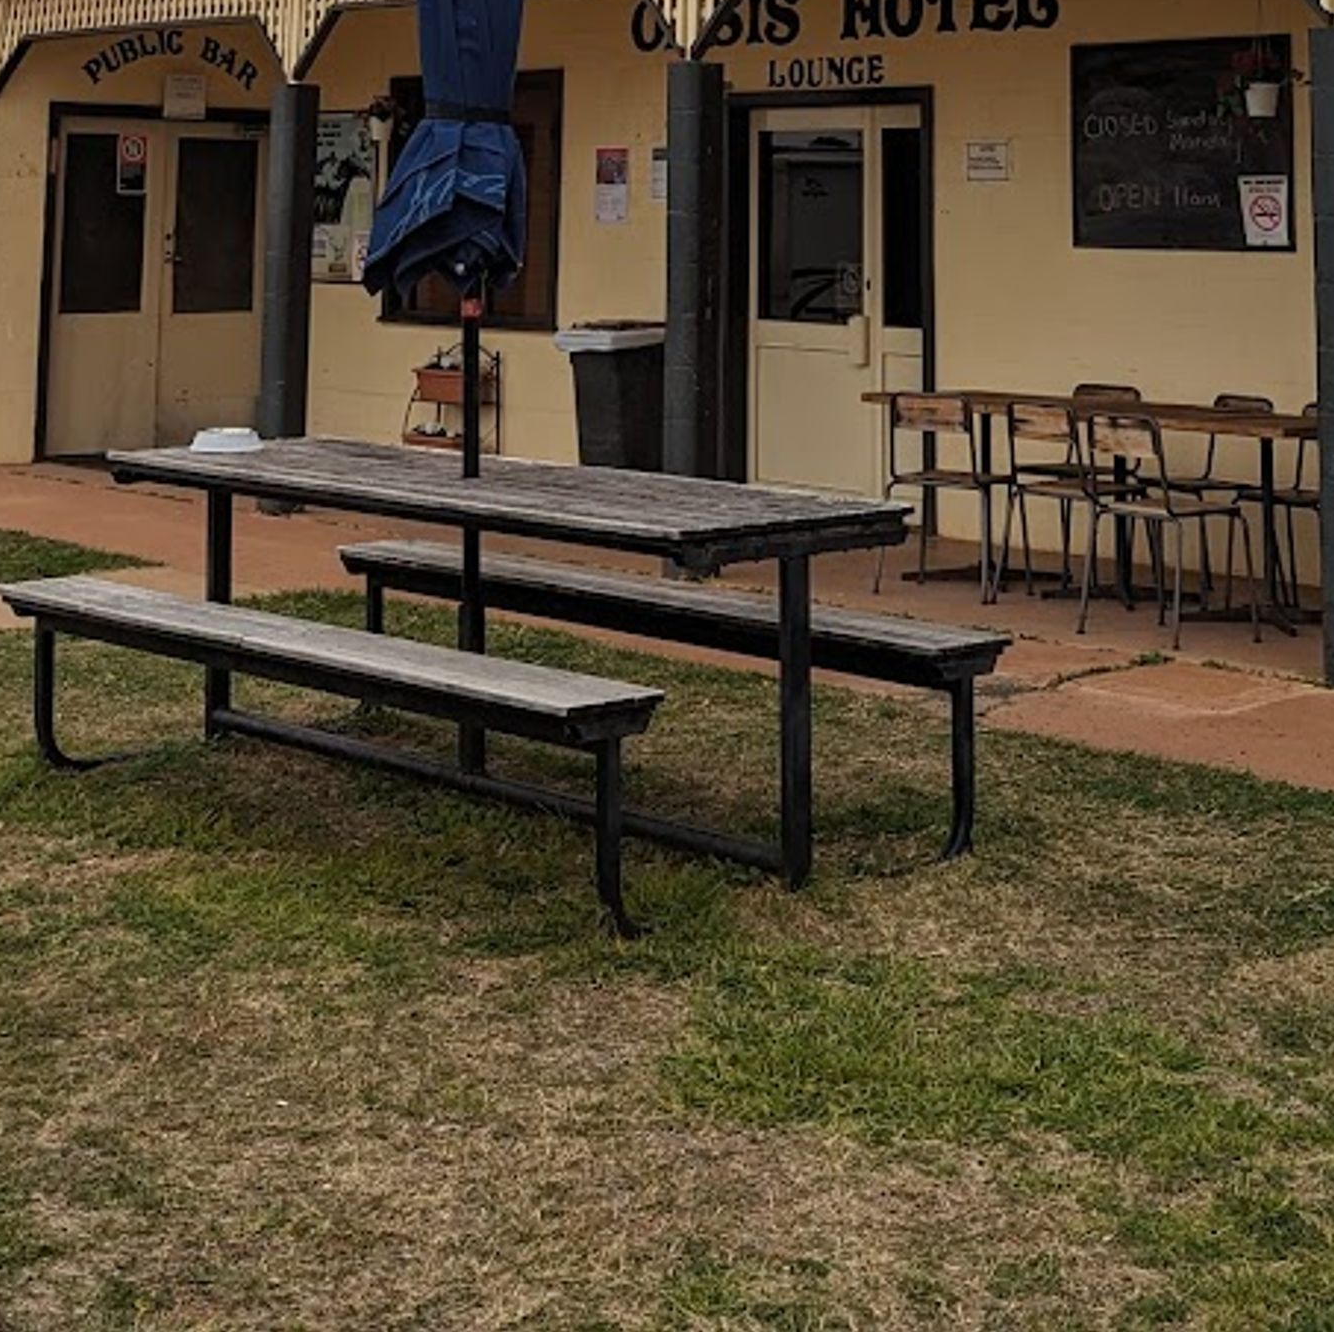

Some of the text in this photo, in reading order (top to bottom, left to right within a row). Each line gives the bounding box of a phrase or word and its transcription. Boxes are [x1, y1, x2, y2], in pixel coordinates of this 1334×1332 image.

[82, 29, 184, 85] PUBLIC
[198, 35, 259, 90] BAR
[768, 54, 885, 89] LOUNGE
[1098, 182, 1161, 212] OPEN
